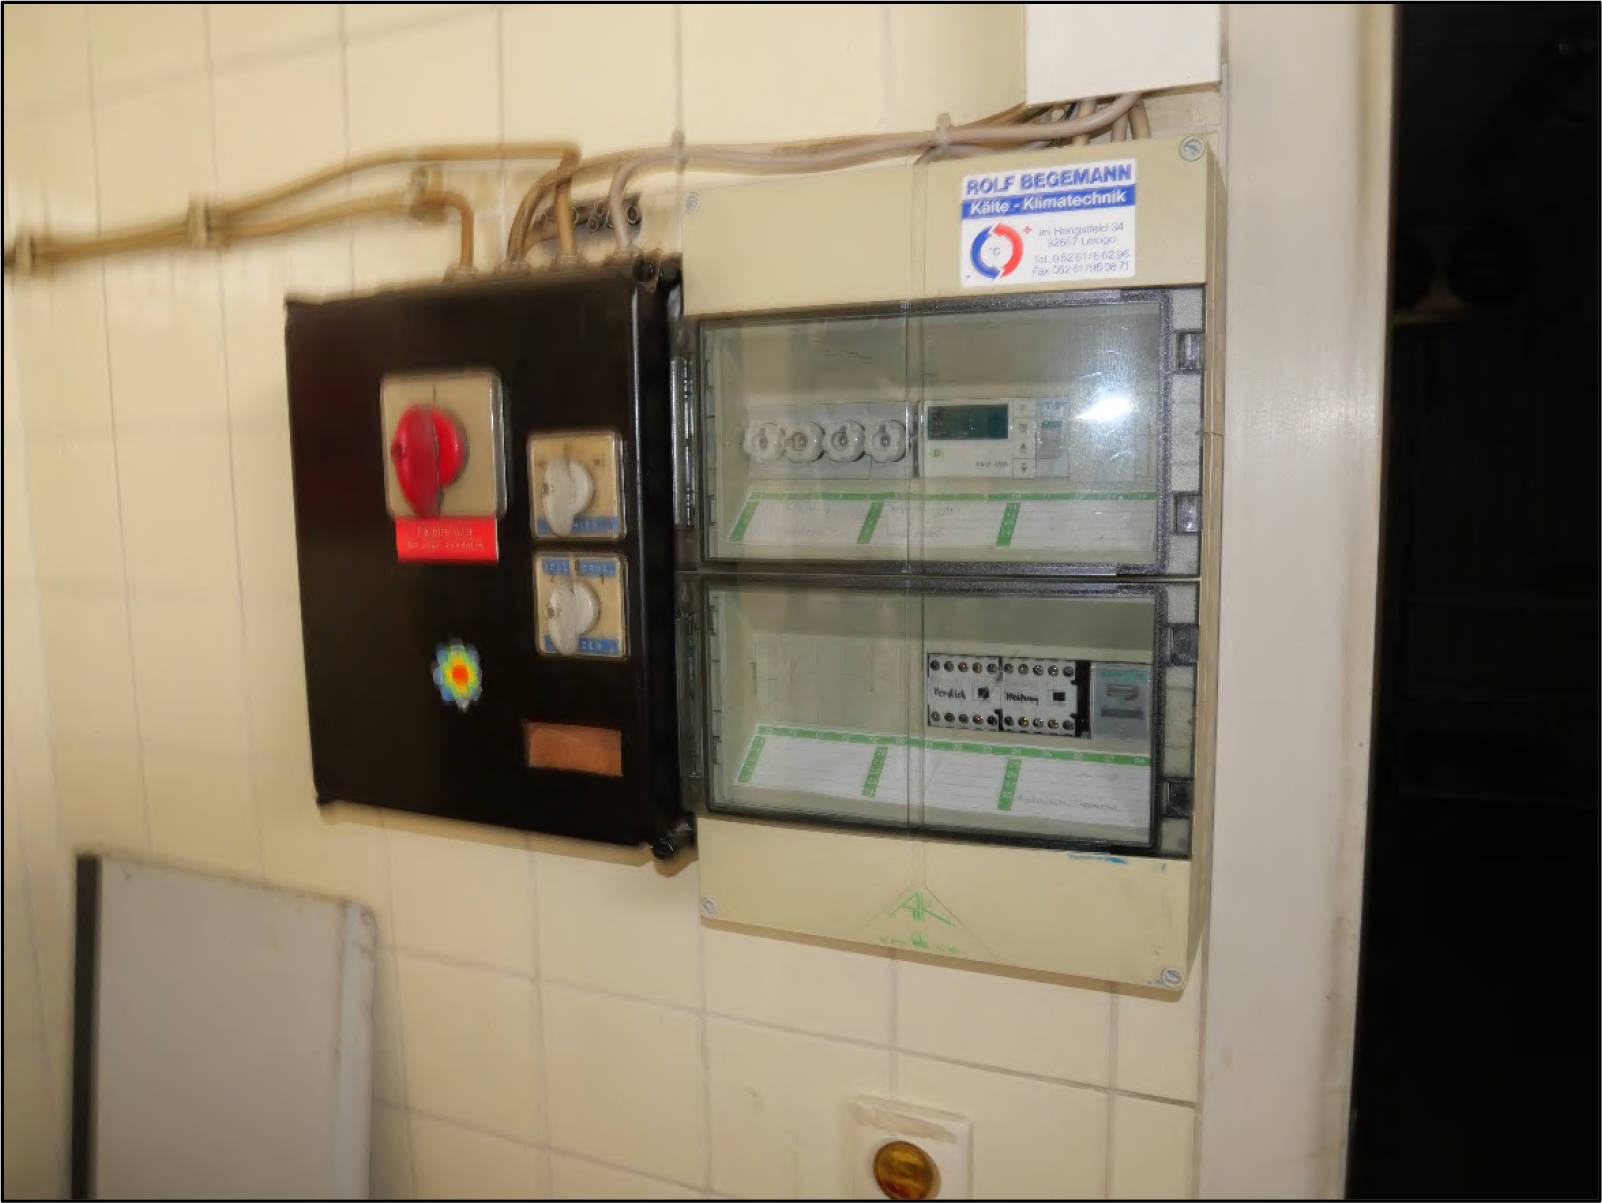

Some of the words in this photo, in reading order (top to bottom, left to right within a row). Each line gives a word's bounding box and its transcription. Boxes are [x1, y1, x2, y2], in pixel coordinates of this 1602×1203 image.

[966, 175, 1016, 196] ROLF
[1020, 163, 1132, 190] BEGEMANN
[970, 200, 1010, 216] Kälte
[1023, 189, 1127, 211] Klimatechnik
